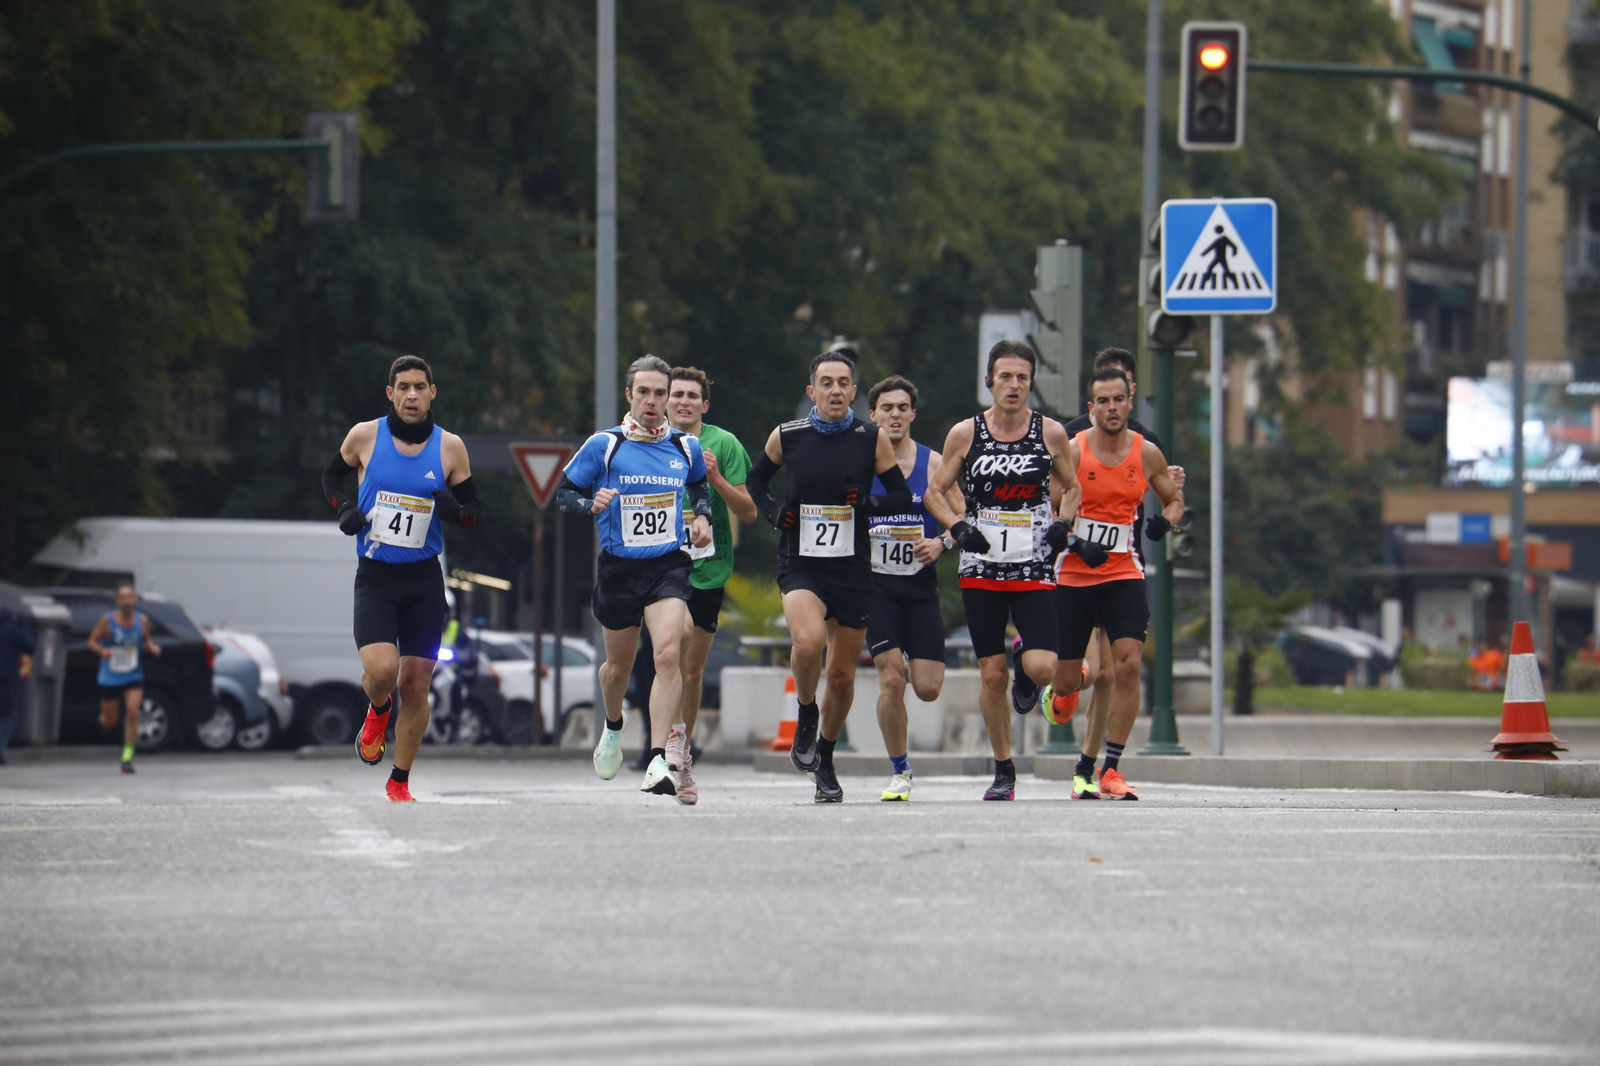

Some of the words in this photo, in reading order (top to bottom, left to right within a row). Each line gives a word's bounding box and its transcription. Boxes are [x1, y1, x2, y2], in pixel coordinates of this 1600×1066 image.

[971, 454, 1041, 477] CORRE
[619, 475, 684, 487] TROTASIERRA
[992, 483, 1040, 500] MUERE
[378, 493, 401, 505] XXXIX
[622, 496, 644, 506] XXXIX
[801, 506, 822, 516] XXXIX
[979, 510, 999, 521] XXXIX
[388, 511, 414, 537] 41
[632, 510, 668, 536] 292
[815, 523, 840, 547] 27
[1000, 529, 1008, 552] 1
[1087, 523, 1119, 551] 170
[880, 542, 914, 565] 146
